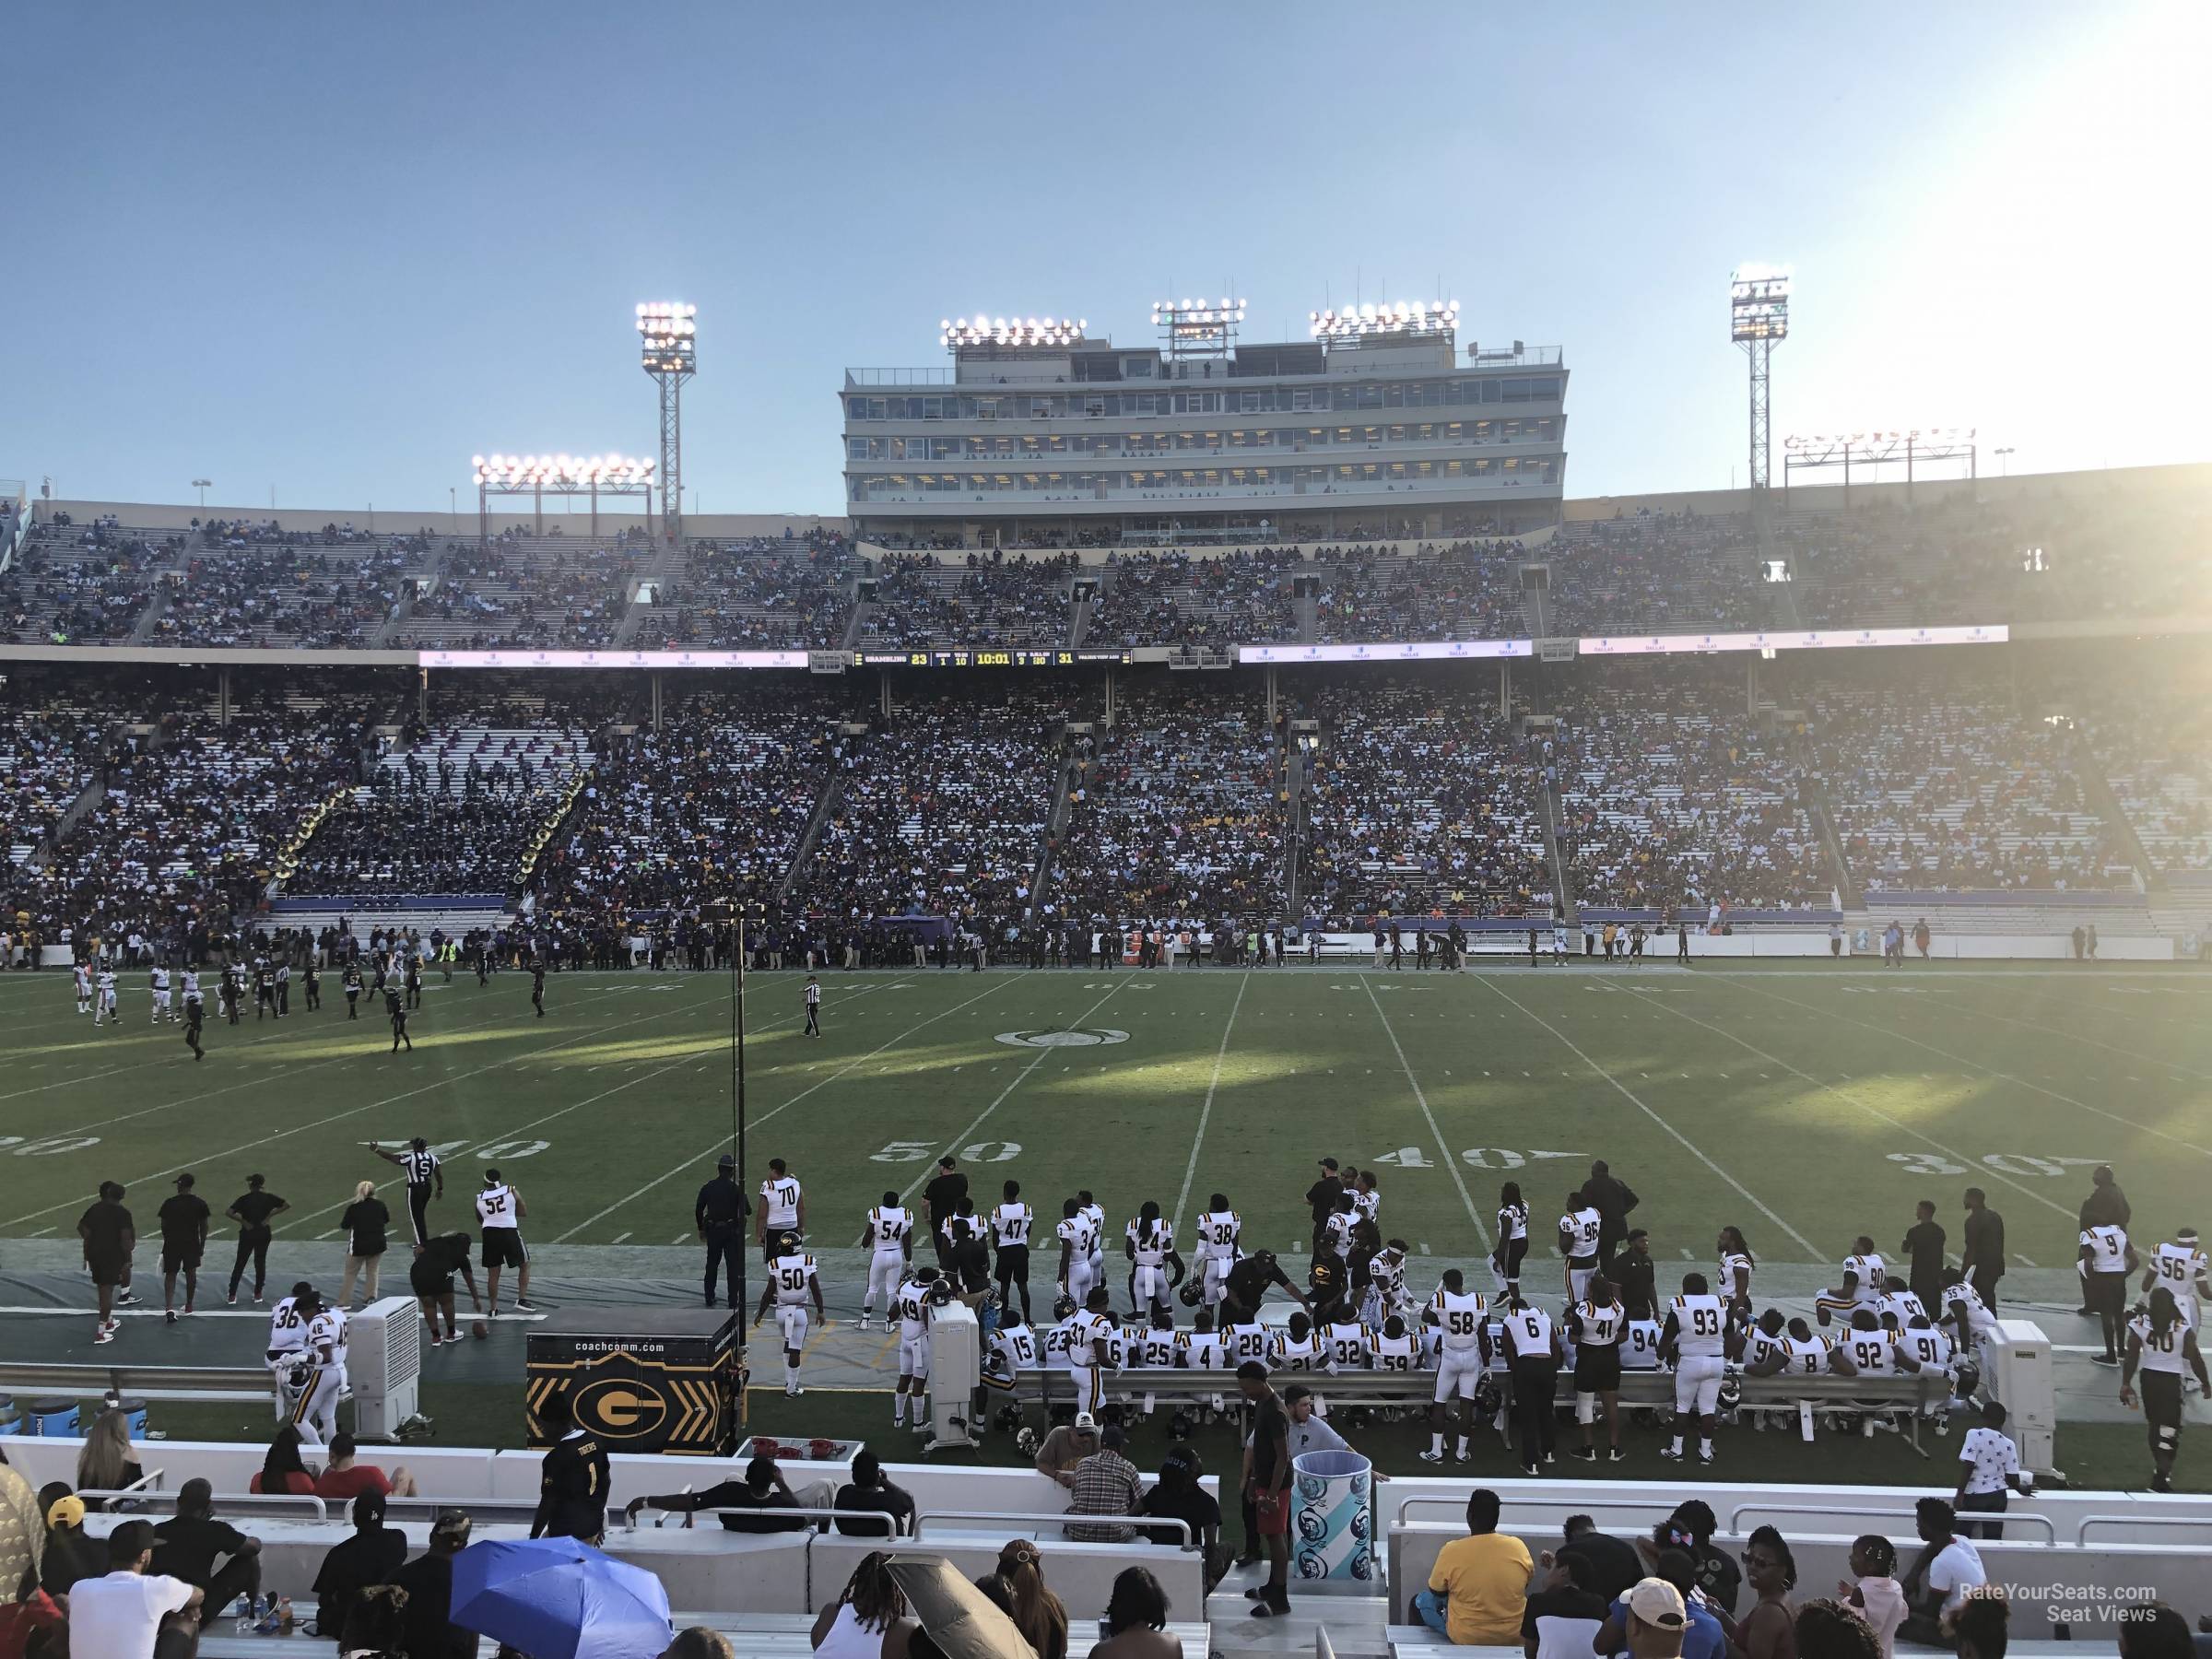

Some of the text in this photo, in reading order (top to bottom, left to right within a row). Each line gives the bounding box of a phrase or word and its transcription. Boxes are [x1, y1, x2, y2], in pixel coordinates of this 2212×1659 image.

[912, 653, 927, 665] 23
[977, 653, 1010, 665] 10:01
[1059, 653, 1074, 664] 31
[350, 975, 359, 984] 57
[869, 1141, 1022, 1162] 50
[1372, 1147, 1526, 1169] 40
[419, 1160, 430, 1175] S
[486, 1197, 506, 1215] 52
[778, 1185, 795, 1207] 70
[881, 1221, 902, 1241] 54
[1006, 1219, 1022, 1239] 47
[1213, 1224, 1232, 1245] 38
[1347, 1226, 1355, 1246] 5
[1584, 1221, 1599, 1242] 96
[1080, 1230, 1088, 1251] 3
[2105, 1234, 2118, 1255] 9
[782, 1268, 804, 1290] 50
[1371, 1264, 1380, 1274] 29
[1869, 1268, 1884, 1289] 90
[2161, 1256, 2185, 1281] 56
[1947, 1288, 1958, 1299] 55
[276, 1305, 299, 1329] 36
[901, 1298, 920, 1321] 49
[312, 1323, 324, 1335] 48
[1449, 1312, 1474, 1335] 58
[1525, 1317, 1540, 1338] 6
[1595, 1320, 1613, 1339] 41
[1693, 1309, 1718, 1335] 93
[1047, 1330, 1070, 1351] 23
[1071, 1322, 1086, 1347] 37
[1433, 1335, 1442, 1355] 4
[1632, 1329, 1658, 1352] 94
[575, 1342, 665, 1352] coachcomm.com
[1013, 1335, 1032, 1361] 15
[1111, 1340, 1121, 1362] 6
[1146, 1342, 1170, 1365] 25
[1240, 1334, 1263, 1357] 28
[1336, 1340, 1360, 1364] 32
[1855, 1342, 1883, 1369] 92
[1917, 1338, 1937, 1363] 91
[1200, 1346, 1210, 1369] 4
[1383, 1355, 1408, 1371] 59
[1805, 1354, 1818, 1373] 8
[1300, 1434, 1309, 1446] P
[588, 1462, 597, 1496] 1
